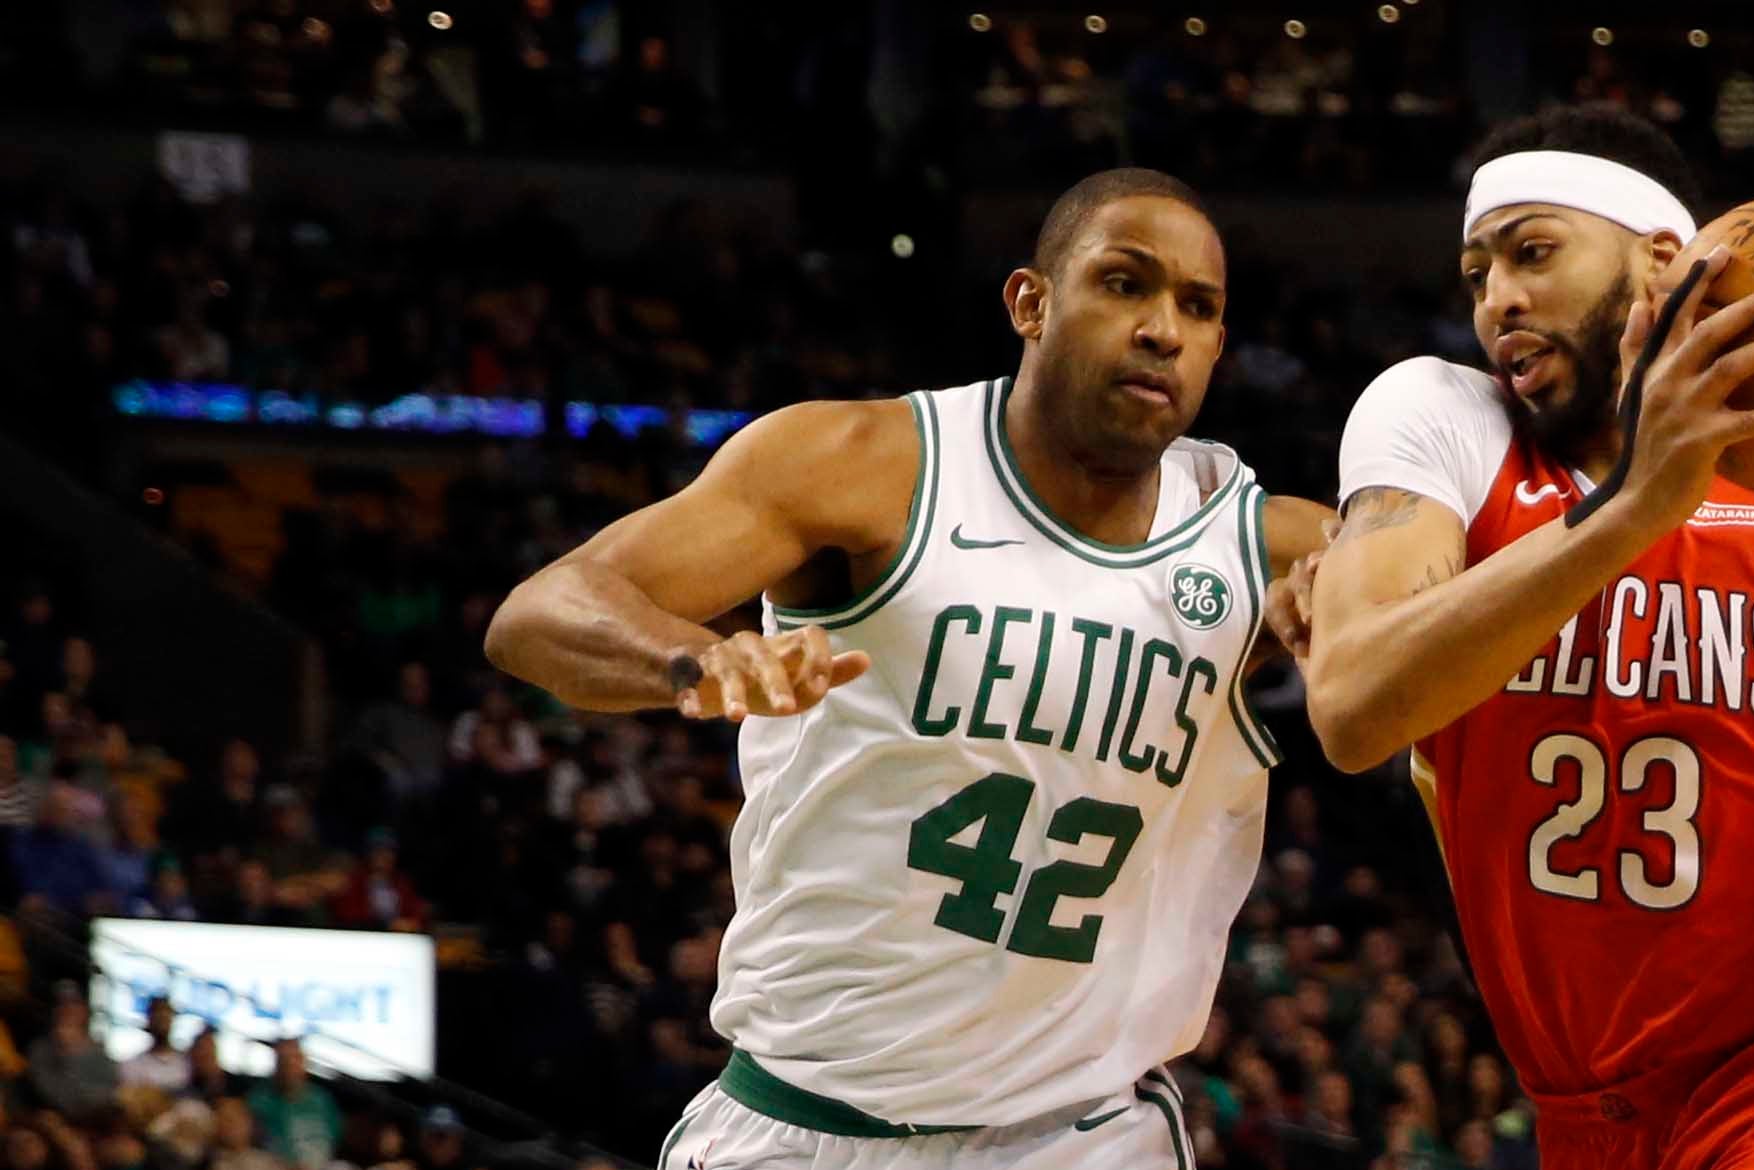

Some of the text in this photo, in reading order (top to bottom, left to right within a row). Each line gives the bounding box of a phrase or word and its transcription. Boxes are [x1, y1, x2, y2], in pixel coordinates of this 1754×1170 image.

[911, 604, 1217, 788] CELTICS
[907, 772, 1143, 963] 42
[1528, 733, 1702, 910] 23
